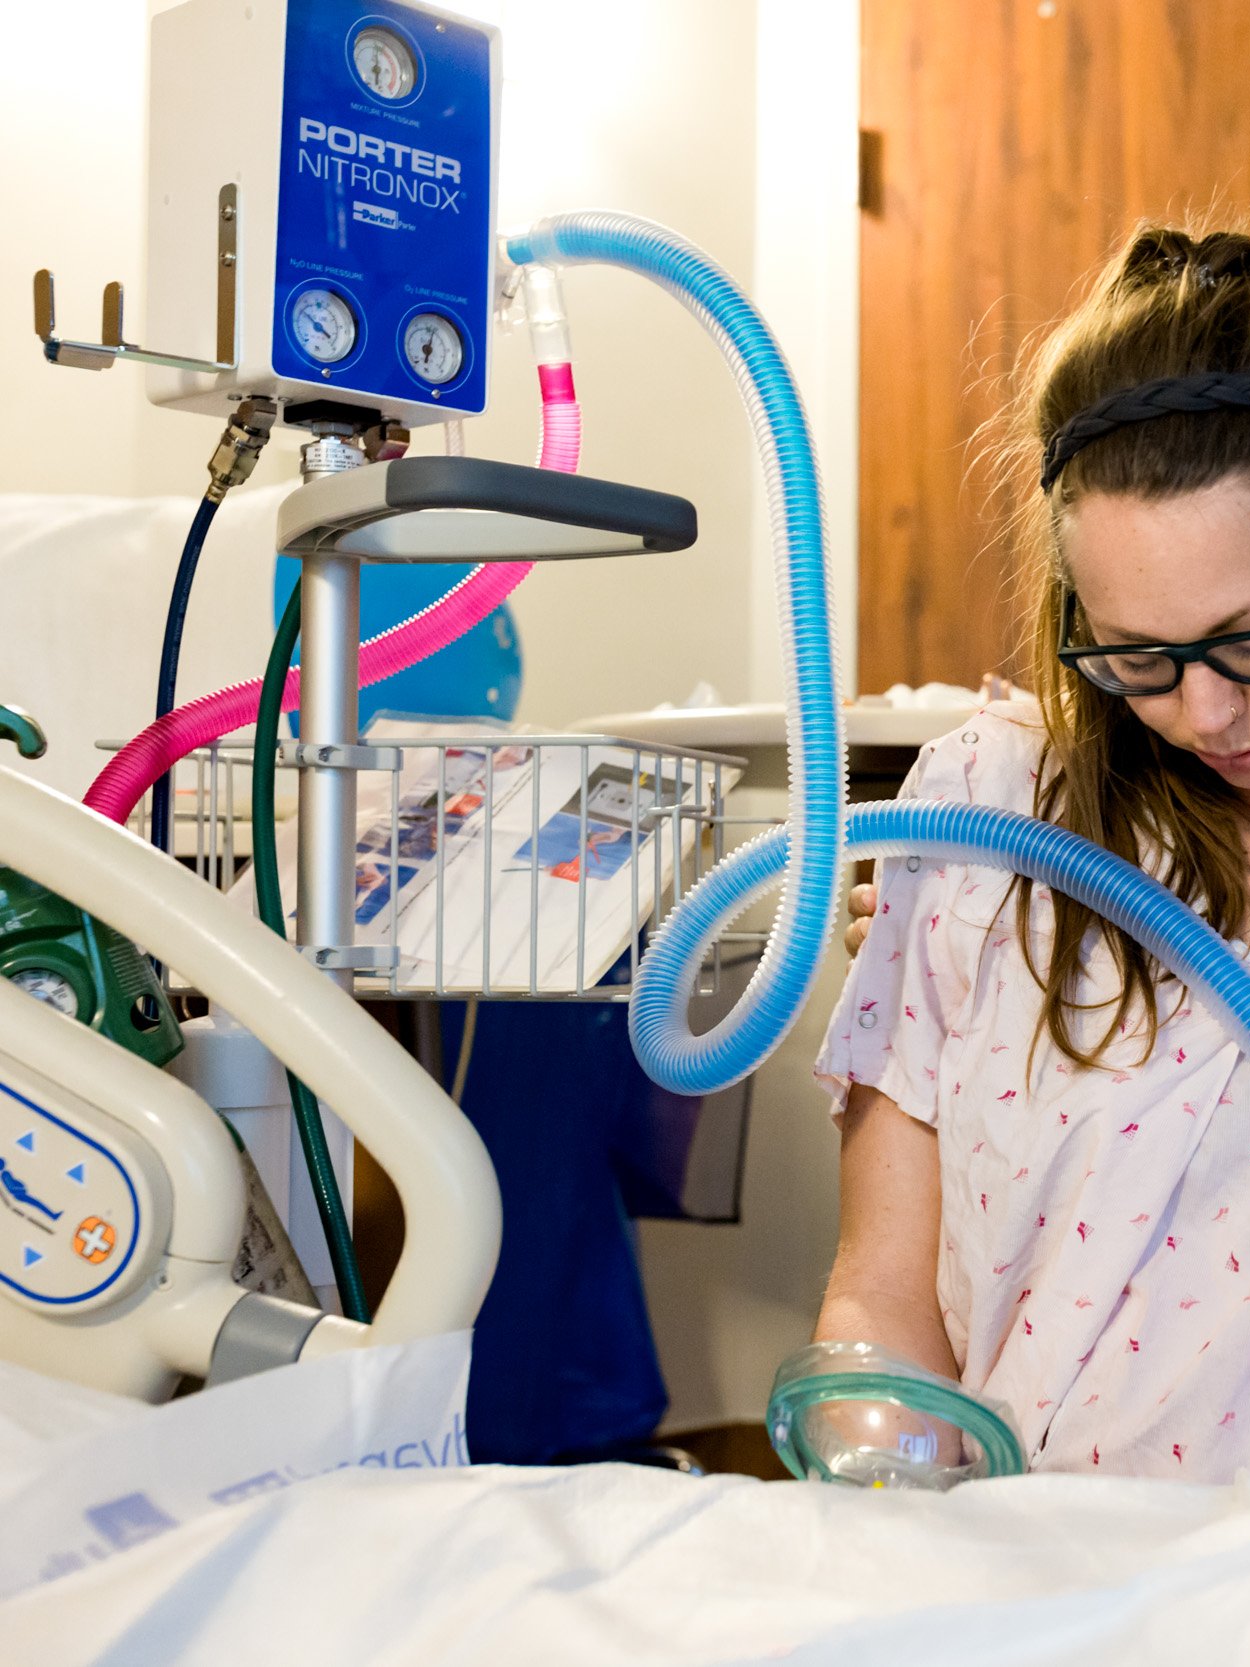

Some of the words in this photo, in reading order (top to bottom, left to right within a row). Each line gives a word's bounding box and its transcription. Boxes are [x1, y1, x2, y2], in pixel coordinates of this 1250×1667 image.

[350, 102, 381, 117] MIXTURE
[383, 111, 420, 128] PRESSURE
[300, 116, 461, 184] PORTER
[362, 208, 396, 226] Parker
[306, 261, 324, 272] LINE
[324, 265, 364, 281] PRESSURE
[415, 287, 431, 297] LINE
[432, 290, 468, 305] PRESSURE
